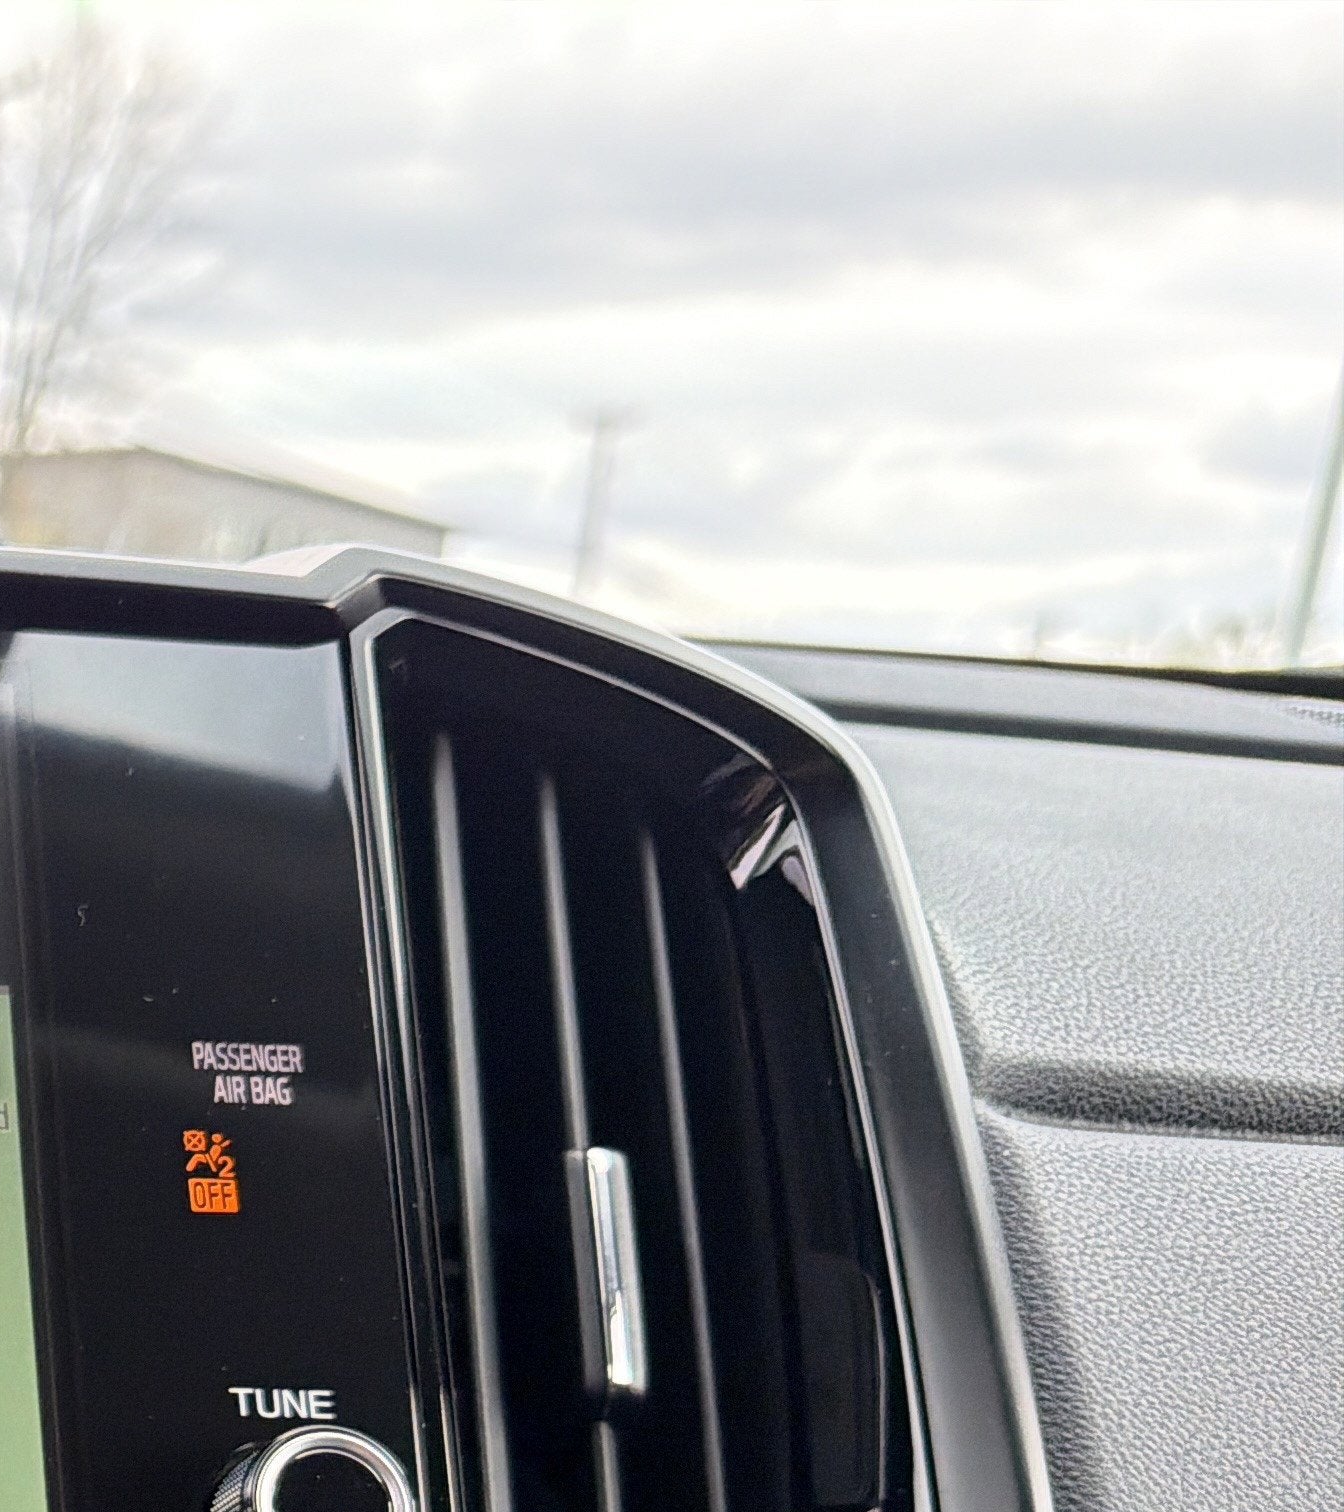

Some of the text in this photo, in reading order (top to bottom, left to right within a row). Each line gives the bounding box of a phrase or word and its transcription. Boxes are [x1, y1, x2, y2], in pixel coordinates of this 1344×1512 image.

[192, 1041, 303, 1073] PASSENGER
[214, 1075, 293, 1105] AIR BAG
[192, 1180, 233, 1210] OFF
[228, 1387, 336, 1420] TUNE
